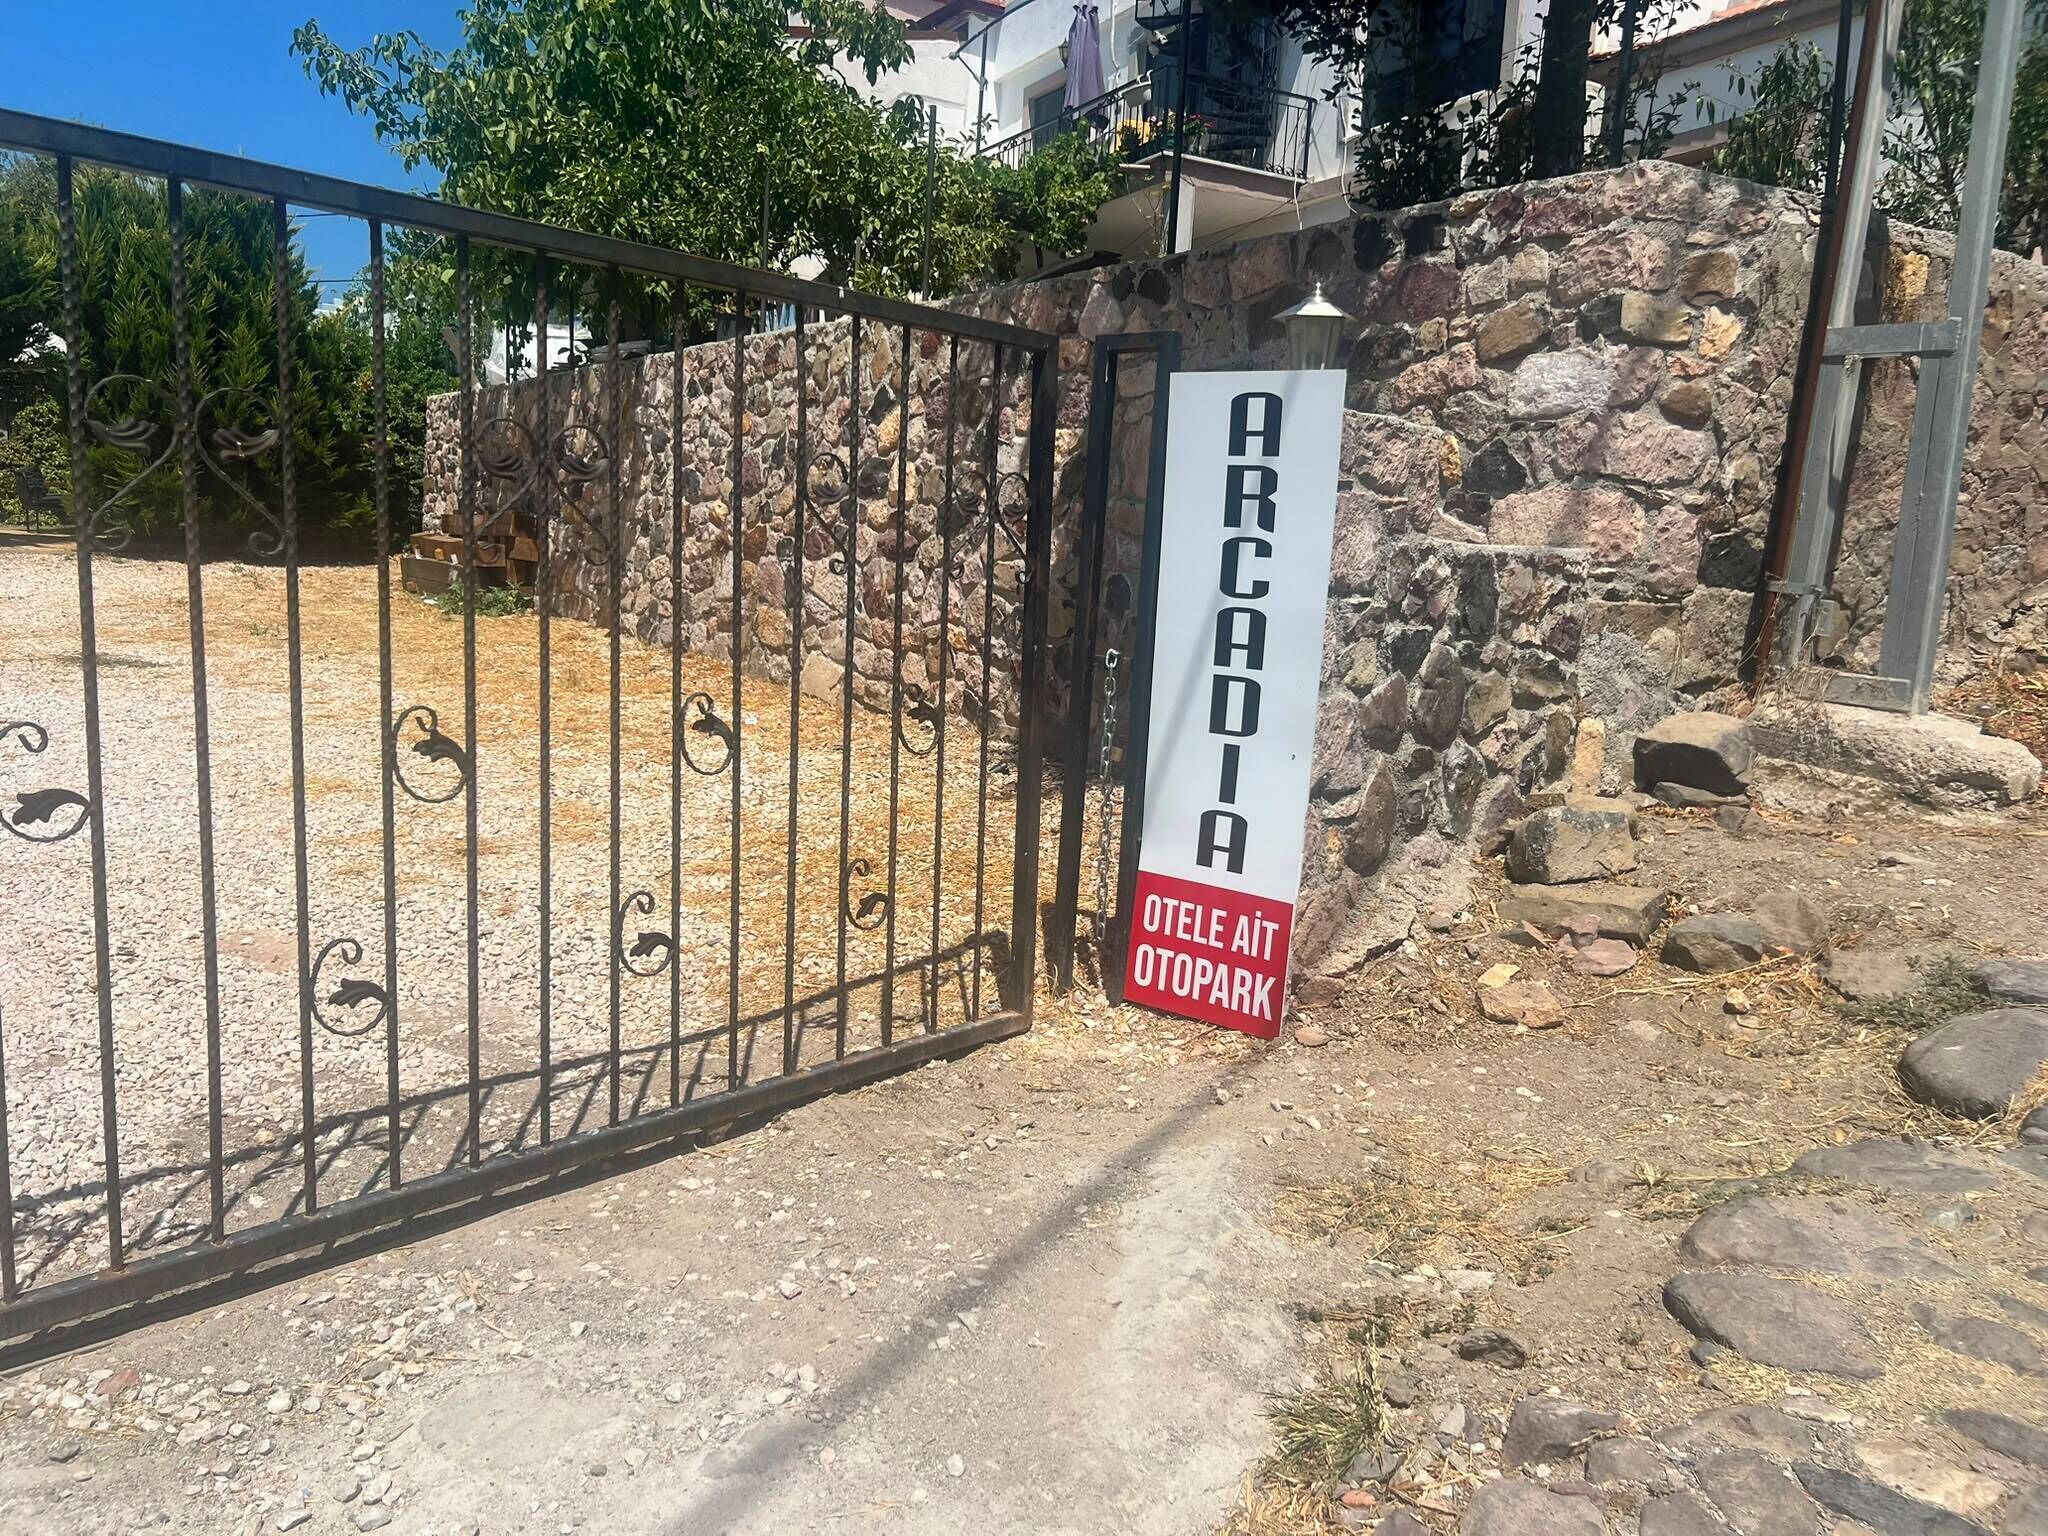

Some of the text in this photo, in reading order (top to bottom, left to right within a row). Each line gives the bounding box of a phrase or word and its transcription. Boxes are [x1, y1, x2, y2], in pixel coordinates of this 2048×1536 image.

[1196, 391, 1283, 874] ARCADIA
[1143, 893, 1279, 961] OTELE AİT
[1133, 943, 1276, 1021] OTOPARK
